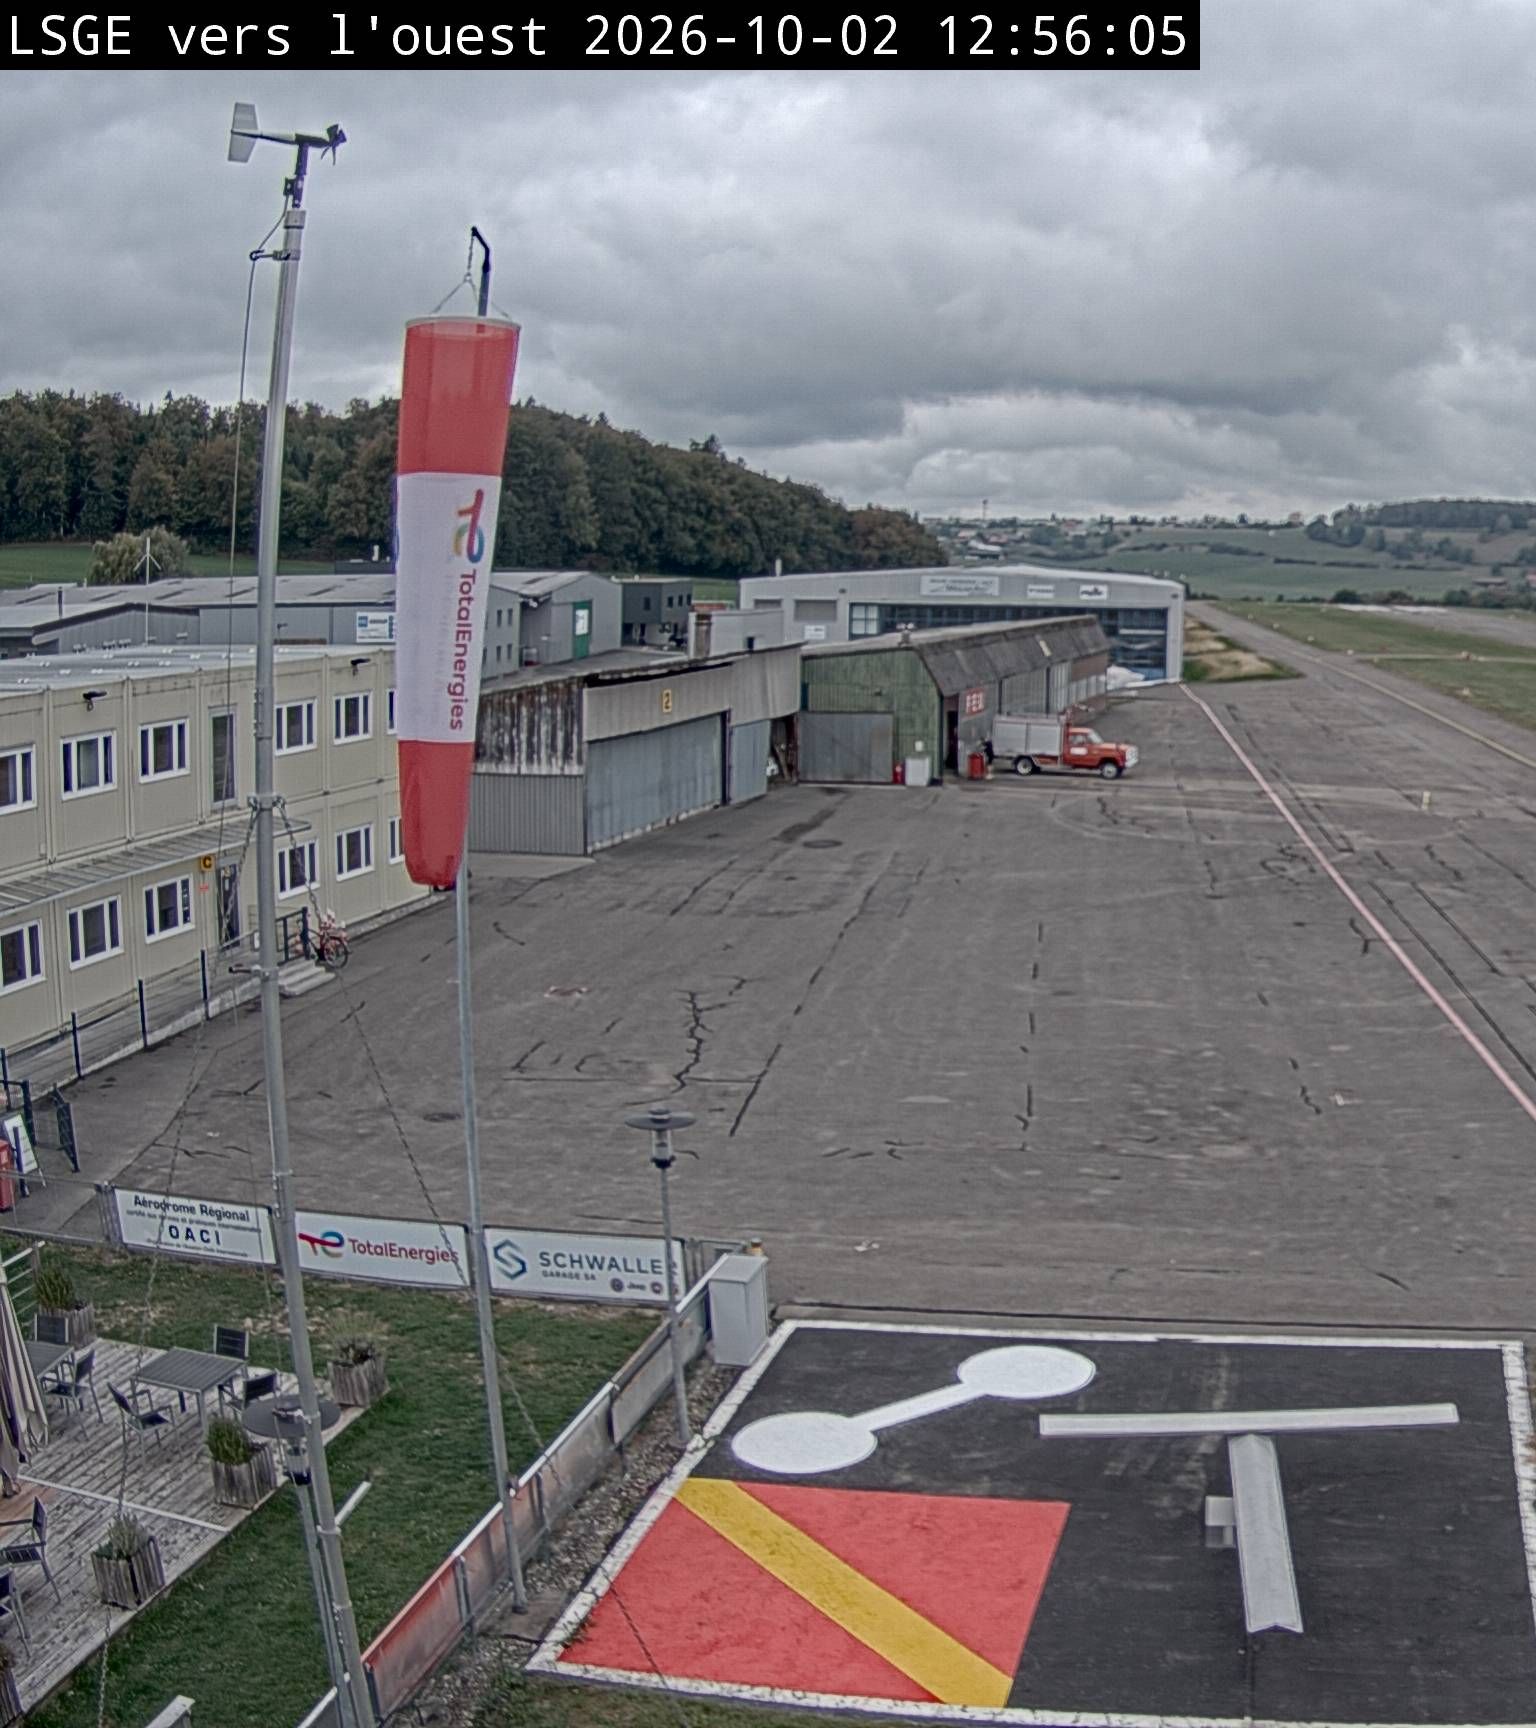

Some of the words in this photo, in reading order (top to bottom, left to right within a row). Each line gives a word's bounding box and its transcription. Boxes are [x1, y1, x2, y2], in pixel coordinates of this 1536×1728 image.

[447, 569, 477, 731] TotalEnergies
[202, 855, 212, 869] C
[134, 1194, 196, 1215] Aérodrome
[200, 1204, 250, 1222] Régional
[168, 1225, 221, 1245] OACI
[348, 1238, 459, 1265] TotalEnergies
[542, 1270, 580, 1281] GARAGE
